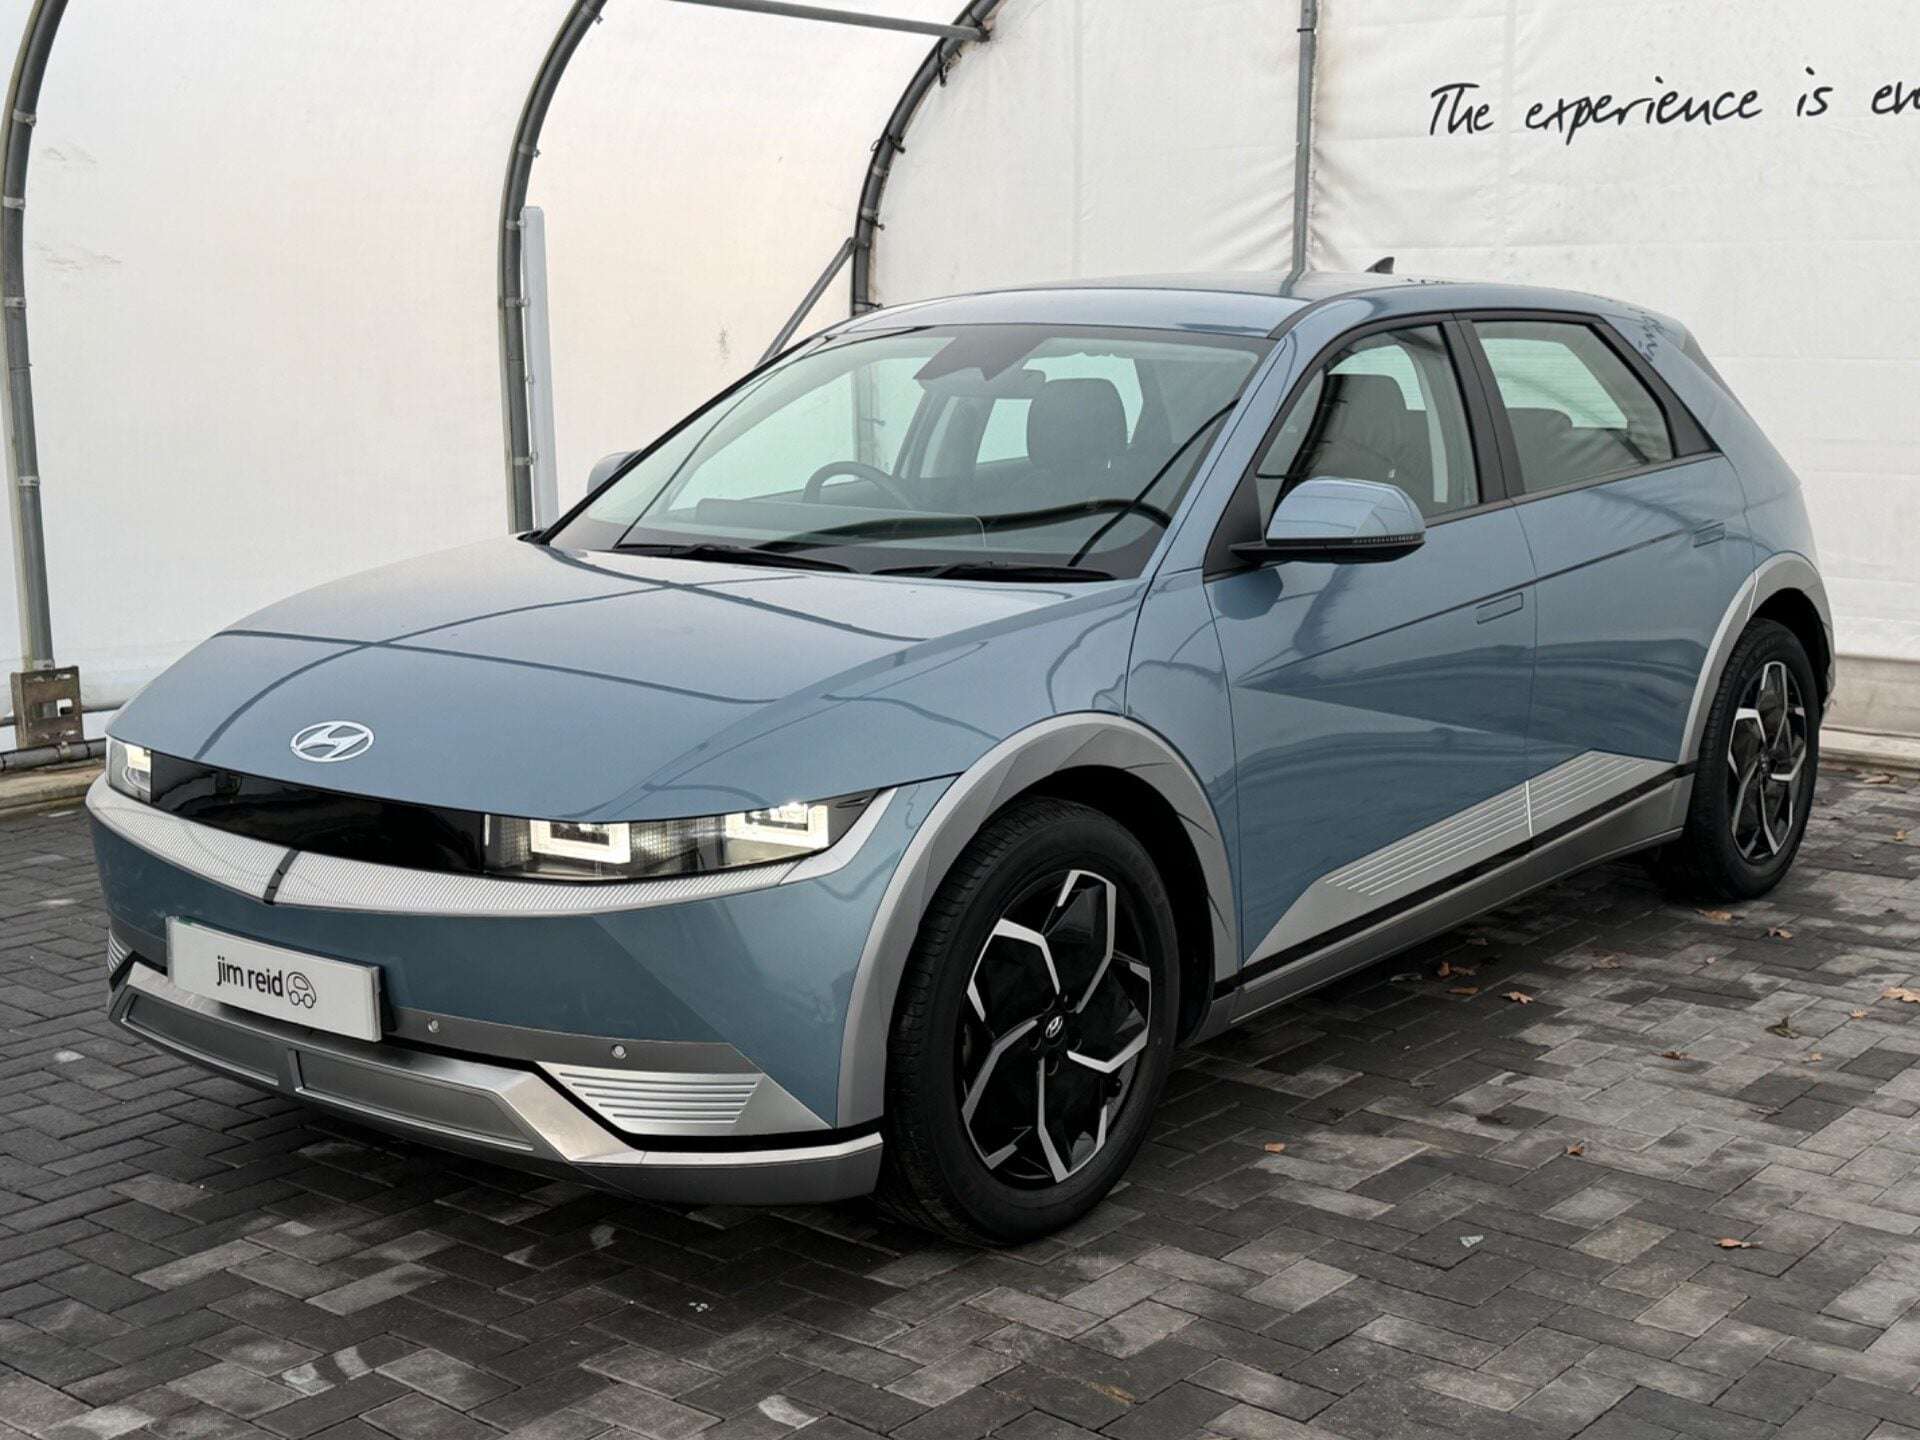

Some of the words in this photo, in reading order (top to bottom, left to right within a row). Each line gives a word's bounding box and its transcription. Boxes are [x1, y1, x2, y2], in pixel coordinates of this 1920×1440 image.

[1430, 83, 1494, 135] The
[1525, 76, 1762, 146] experience
[1797, 67, 1833, 117] is
[216, 955, 244, 987] jim
[247, 968, 284, 998] reid
